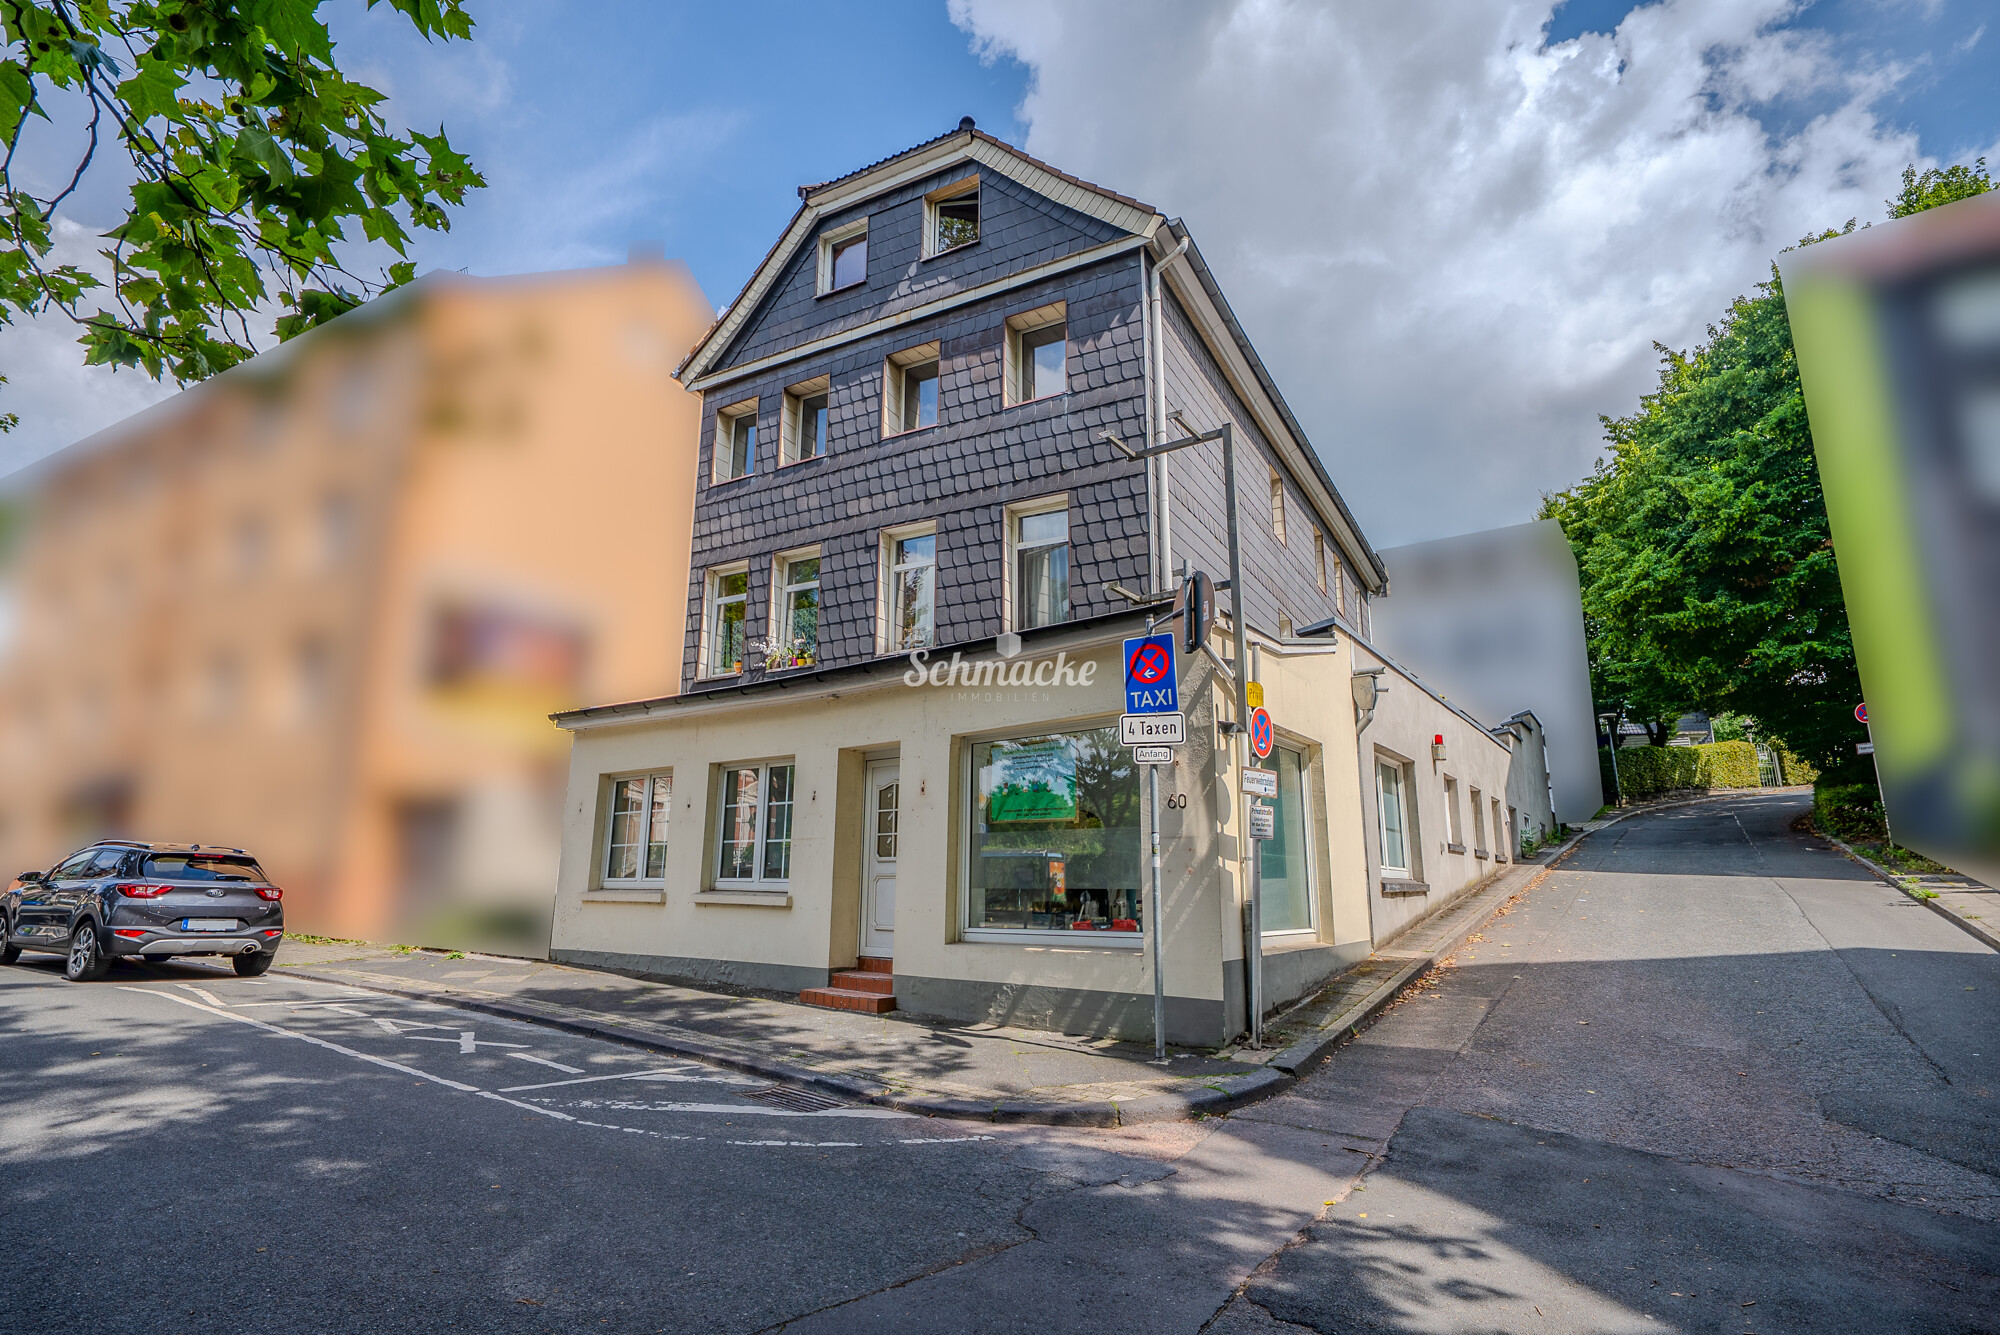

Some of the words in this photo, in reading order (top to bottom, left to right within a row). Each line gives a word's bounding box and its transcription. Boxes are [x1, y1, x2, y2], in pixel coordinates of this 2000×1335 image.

[1130, 688, 1173, 708] TAXI
[1128, 721, 1135, 736] 4
[1139, 720, 1177, 736] Taxen
[1138, 749, 1169, 760] Anfang
[1167, 793, 1187, 809] 60
